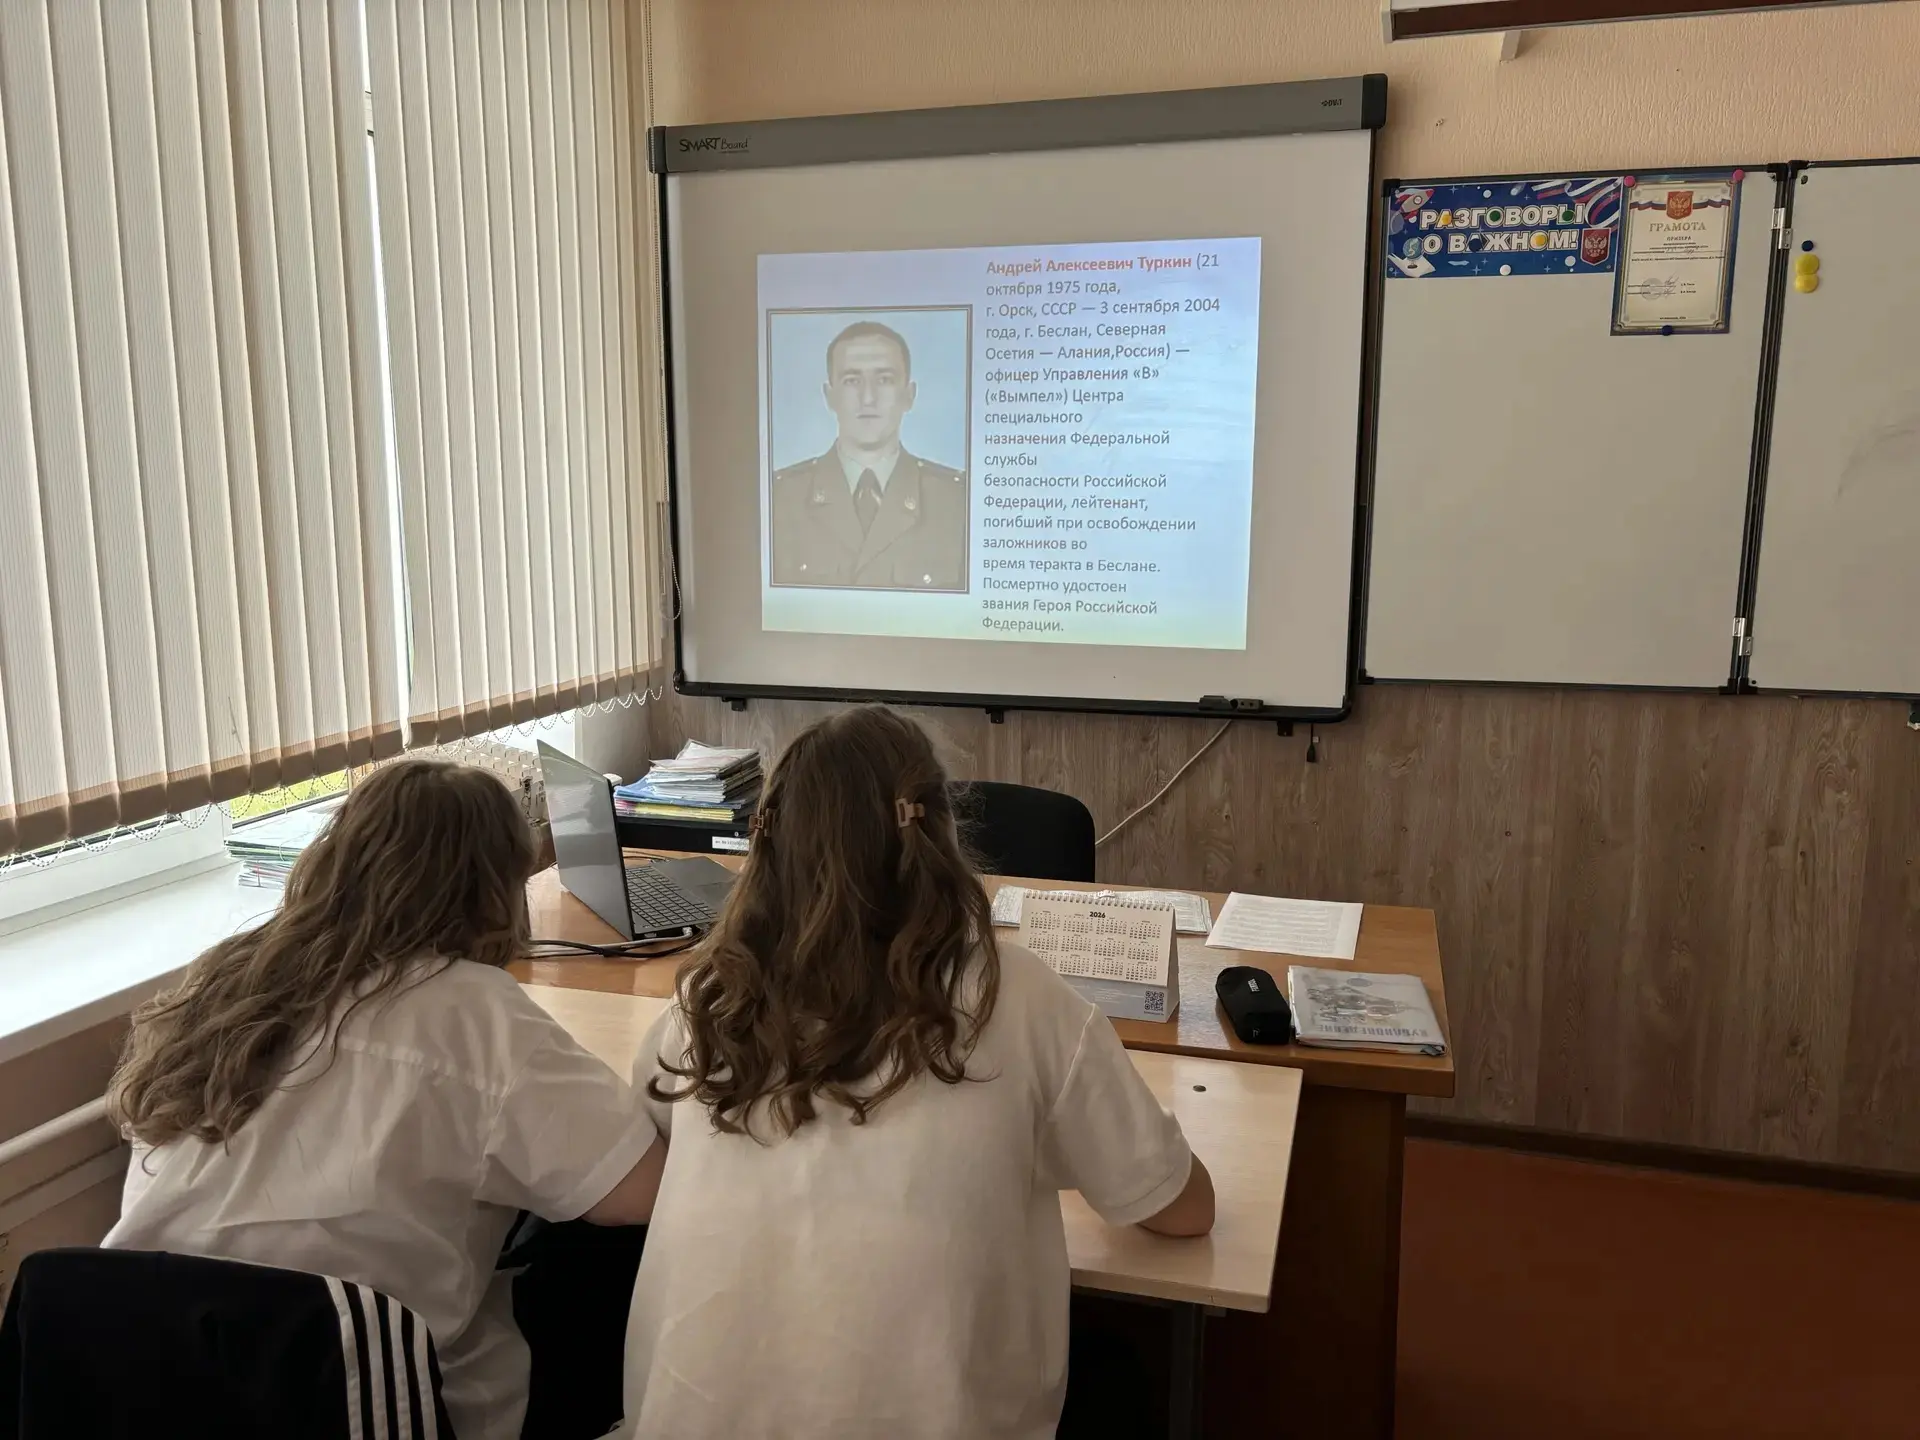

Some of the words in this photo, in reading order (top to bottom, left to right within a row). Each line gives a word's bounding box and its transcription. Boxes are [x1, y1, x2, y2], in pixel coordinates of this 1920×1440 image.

[679, 137, 721, 153] SMART
[720, 138, 749, 151] Board
[1420, 203, 1586, 230] РАЗГОВОРЫ
[1649, 221, 1707, 232] ГРАМОТА
[1422, 233, 1443, 254] О
[986, 259, 1042, 276] Андрей
[1046, 260, 1133, 272] Алексеевич
[1137, 256, 1192, 272] Туркин
[1196, 253, 1218, 270] (21
[986, 282, 1042, 297] октября
[1048, 282, 1080, 294] 1975
[1086, 284, 1120, 295] года,
[986, 307, 994, 316] г.
[999, 306, 1037, 318] Орск,
[1042, 303, 1076, 315] СССР
[1100, 302, 1108, 314] 3
[1112, 300, 1180, 316] сентября
[1184, 299, 1220, 312] 2004
[986, 328, 1020, 340] года,
[1025, 328, 1032, 338] г.
[1038, 326, 1092, 339] Беслан,
[1096, 324, 1166, 338] Северная
[986, 348, 1034, 360] Осетия
[1058, 344, 1170, 360] Алания,Россия)
[986, 368, 1038, 385] офицер
[1043, 368, 1128, 384] Управления
[1134, 367, 1159, 379] «В»
[986, 390, 1068, 405] («Вымпел»)
[1072, 389, 1124, 404] Центра
[984, 412, 1082, 426] специального
[984, 433, 1066, 444] назначения
[1071, 432, 1170, 447] Федеральной
[984, 452, 1036, 468] службы
[984, 474, 1078, 488] безопасности
[1084, 474, 1167, 488] Российской
[984, 496, 1067, 511] Федерации,
[1071, 496, 1148, 511] лейтенант,
[984, 516, 1052, 528] погибший
[1057, 519, 1082, 532] при
[1088, 516, 1196, 532] освобождении
[984, 538, 1066, 550] заложников
[1072, 540, 1087, 550] во
[984, 559, 1025, 573] время
[1030, 560, 1082, 573] теракта
[1086, 562, 1094, 570] в
[1098, 560, 1160, 572] Беслане.
[983, 578, 1058, 593] Посмертно
[1063, 580, 1126, 594] удостоен
[982, 599, 1028, 611] звания
[1033, 600, 1071, 614] Героя
[1076, 600, 1157, 614] Российской
[982, 617, 1064, 632] Федерации.
[1089, 911, 1106, 919] 2026
